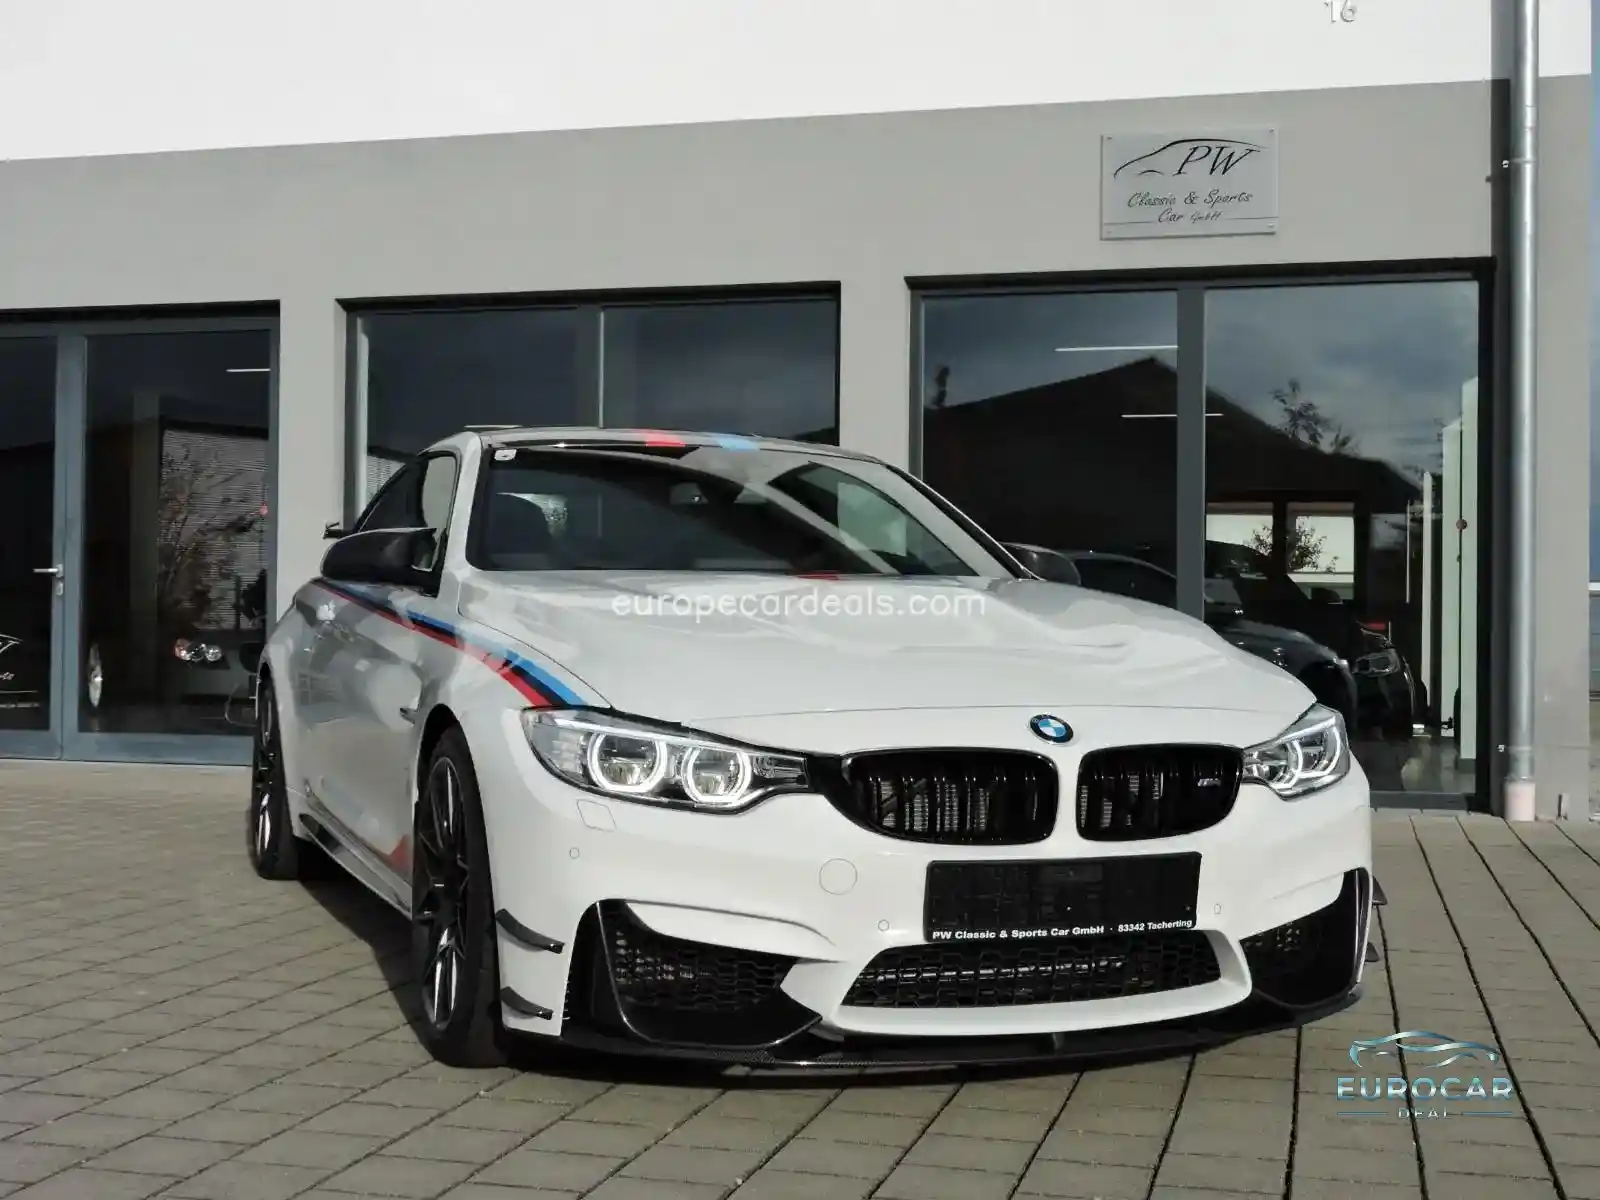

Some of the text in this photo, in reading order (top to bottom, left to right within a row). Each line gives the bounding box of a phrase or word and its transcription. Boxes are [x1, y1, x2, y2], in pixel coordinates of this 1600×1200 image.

[1322, 0, 1357, 22] 16
[1173, 145, 1260, 176] PW
[1127, 189, 1253, 209] Classic & Sports
[1158, 207, 1184, 223] Car
[932, 919, 1193, 940] PW Classic & Sports Car GmbH 83342 Tacherting
